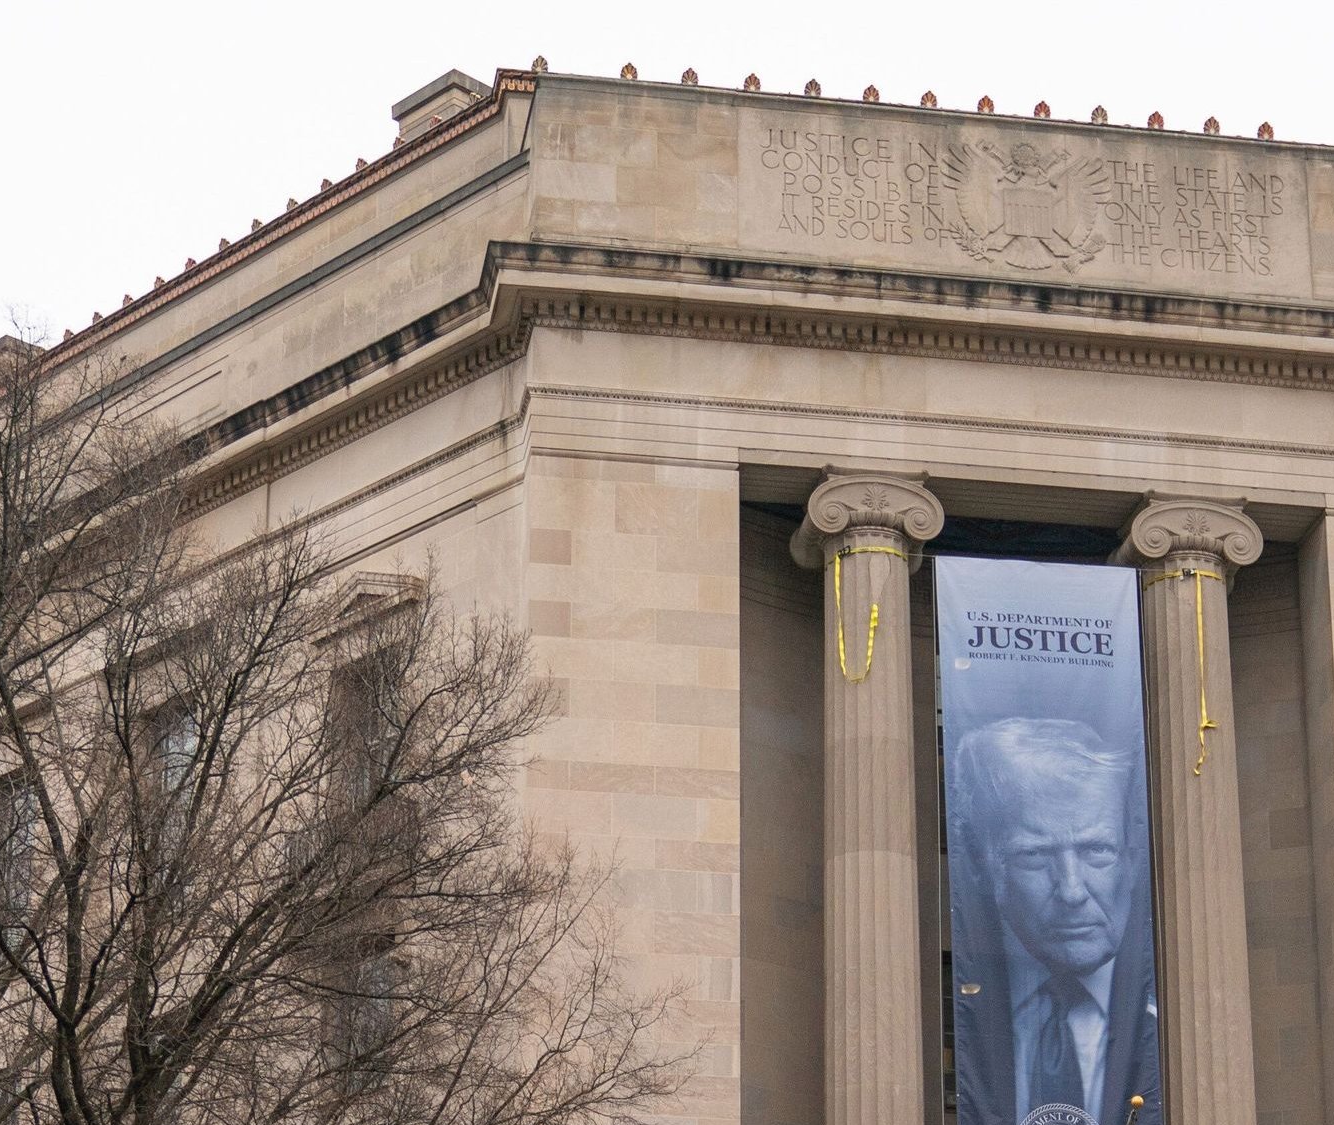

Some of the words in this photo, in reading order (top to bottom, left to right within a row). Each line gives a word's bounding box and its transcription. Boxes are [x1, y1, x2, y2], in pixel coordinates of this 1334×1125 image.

[760, 129, 891, 159] JUSTICE
[909, 142, 937, 162] IN
[761, 150, 894, 180] CONDUCT
[905, 163, 938, 184] OF
[1107, 160, 1157, 183] THE
[1173, 166, 1220, 190] LIFE
[1233, 172, 1284, 195] AND
[784, 172, 941, 205] POSSIBLE
[1114, 182, 1161, 204] THE
[1175, 188, 1247, 213] STATE
[1263, 195, 1283, 215] IS
[781, 193, 799, 215] IT
[812, 196, 910, 223] RESIDES
[921, 206, 944, 225] IN
[1104, 202, 1165, 226] ONLY
[1173, 208, 1202, 228] AS
[1212, 211, 1269, 234] FIRST
[777, 214, 825, 236] AND
[835, 219, 913, 244] SOULS
[924, 227, 952, 248] OF
[1114, 223, 1163, 246] THE
[1178, 229, 1271, 255] HEARTS
[1106, 243, 1152, 265] THE
[1161, 248, 1273, 277] CITIZENS.
[967, 612, 993, 622] U.S.
[997, 613, 1092, 627] DEPARTMENT
[1094, 619, 1113, 629] OF
[968, 626, 1114, 656] JUSTICE
[969, 652, 1008, 660] ROBERT
[1021, 654, 1066, 663] KENNEDY
[1068, 658, 1114, 668] BUILDING
[1066, 1114, 1080, 1124] OF
